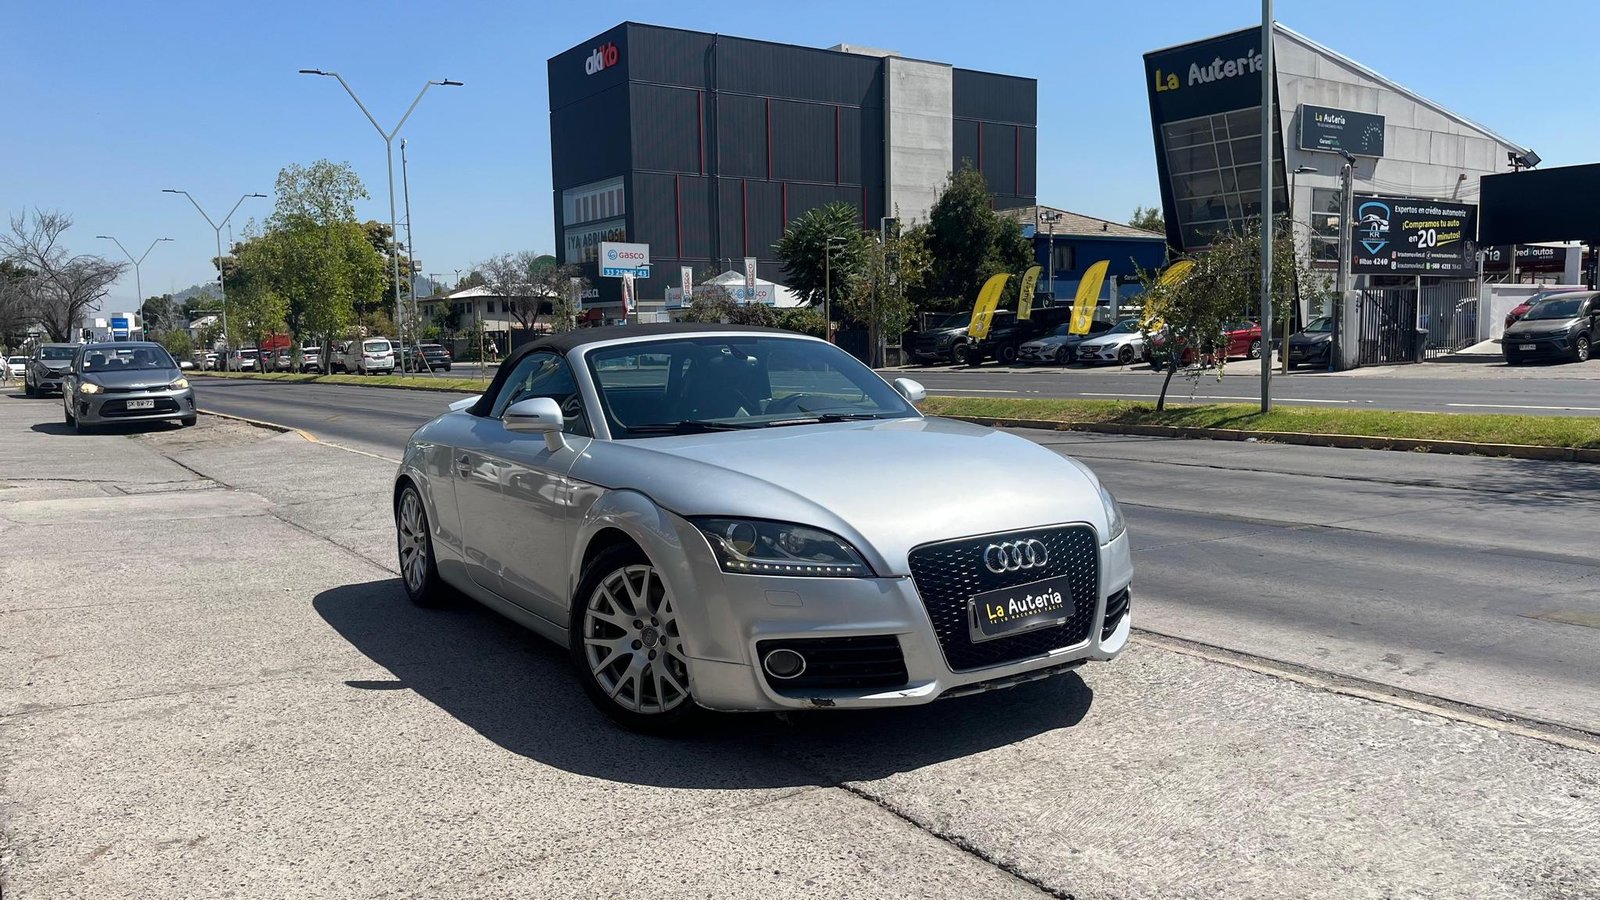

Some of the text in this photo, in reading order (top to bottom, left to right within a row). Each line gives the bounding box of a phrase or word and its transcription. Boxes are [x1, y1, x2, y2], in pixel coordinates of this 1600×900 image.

[1155, 48, 1262, 92] La Autería
[1315, 112, 1346, 125] La Autería
[1394, 205, 1417, 215] Expertos
[1425, 206, 1441, 215] crédito
[1442, 208, 1467, 217] automotriz
[1402, 219, 1460, 230] ¡Compramos tu auto
[1408, 229, 1461, 248] en 20 minutos!
[986, 587, 1062, 620] La Autería
